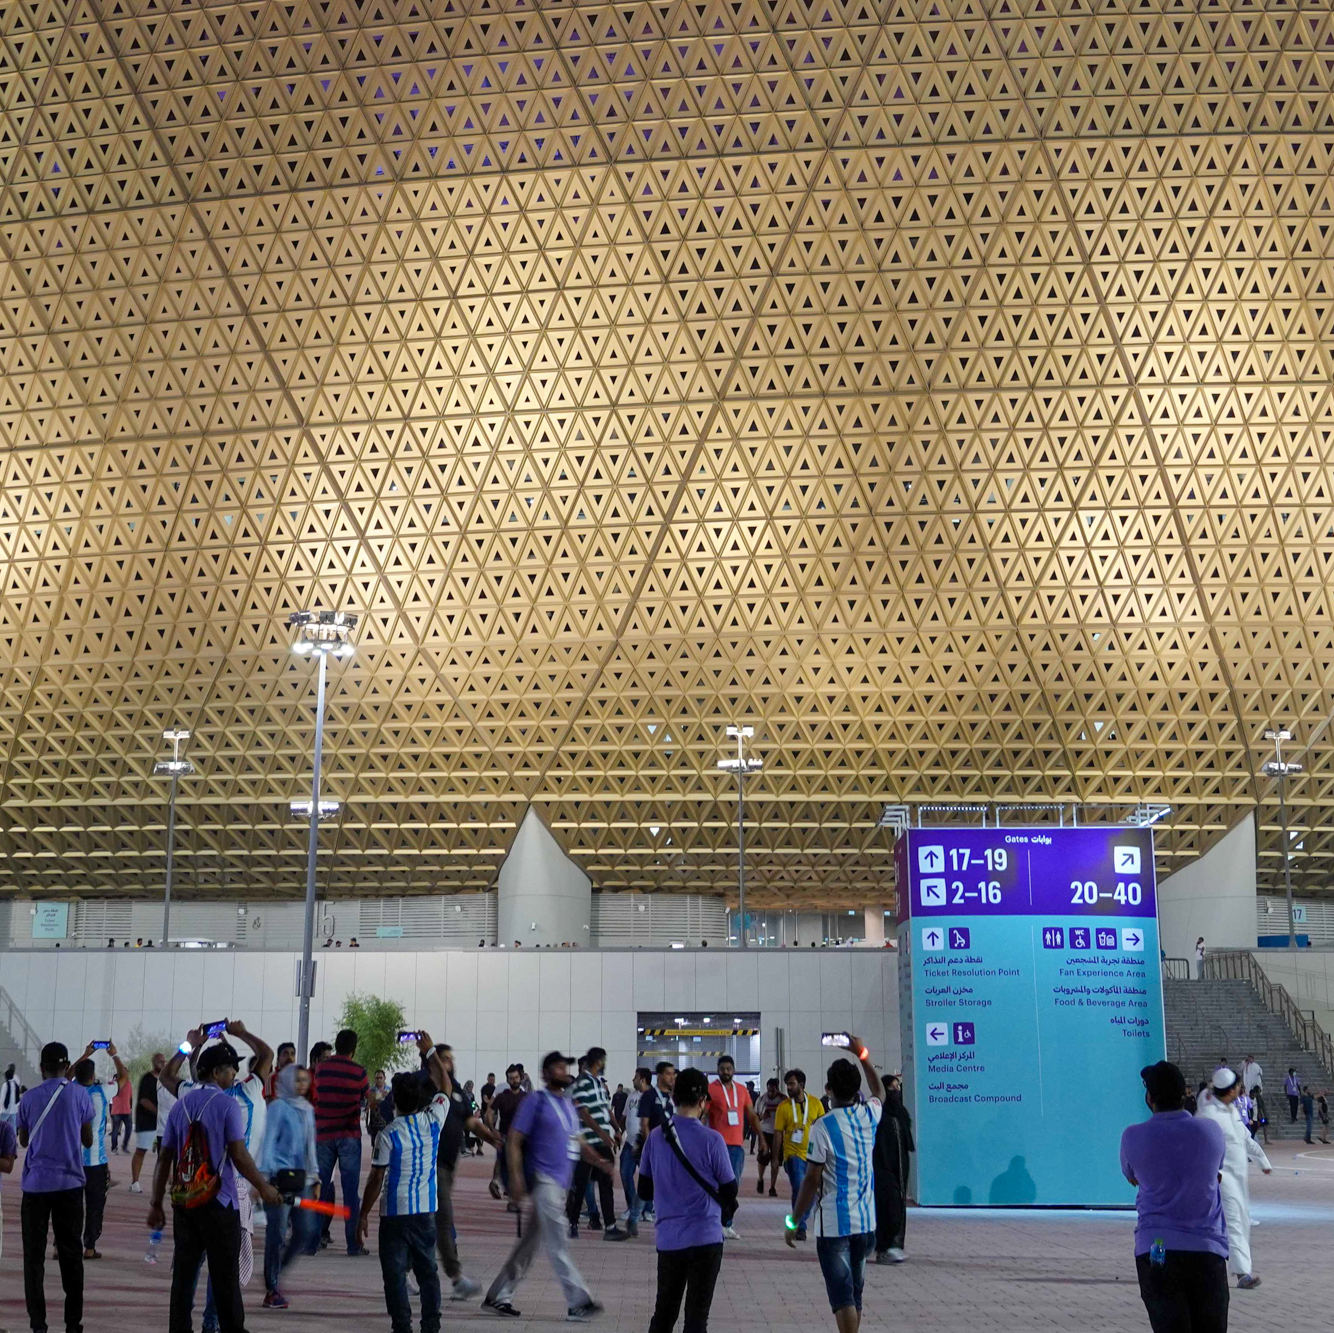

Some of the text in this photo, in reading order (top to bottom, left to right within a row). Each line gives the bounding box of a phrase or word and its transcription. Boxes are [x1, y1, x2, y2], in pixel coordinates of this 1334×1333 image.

[1005, 835, 1028, 843] Gates
[949, 848, 1008, 871] 17-19
[951, 881, 1002, 904] 2-16
[1070, 881, 1142, 905] 20-40
[1292, 908, 1302, 920] 17
[924, 968, 1020, 977] Ticket Resolution Point
[1059, 968, 1146, 978] Fan Experience Area
[925, 998, 992, 1007] Stroller Storage
[1054, 998, 1148, 1008] Food & Beverage Area
[1122, 1029, 1150, 1038] Toilets
[928, 1064, 985, 1073] Media Centre
[928, 1094, 1022, 1103] Broadcast Compound
